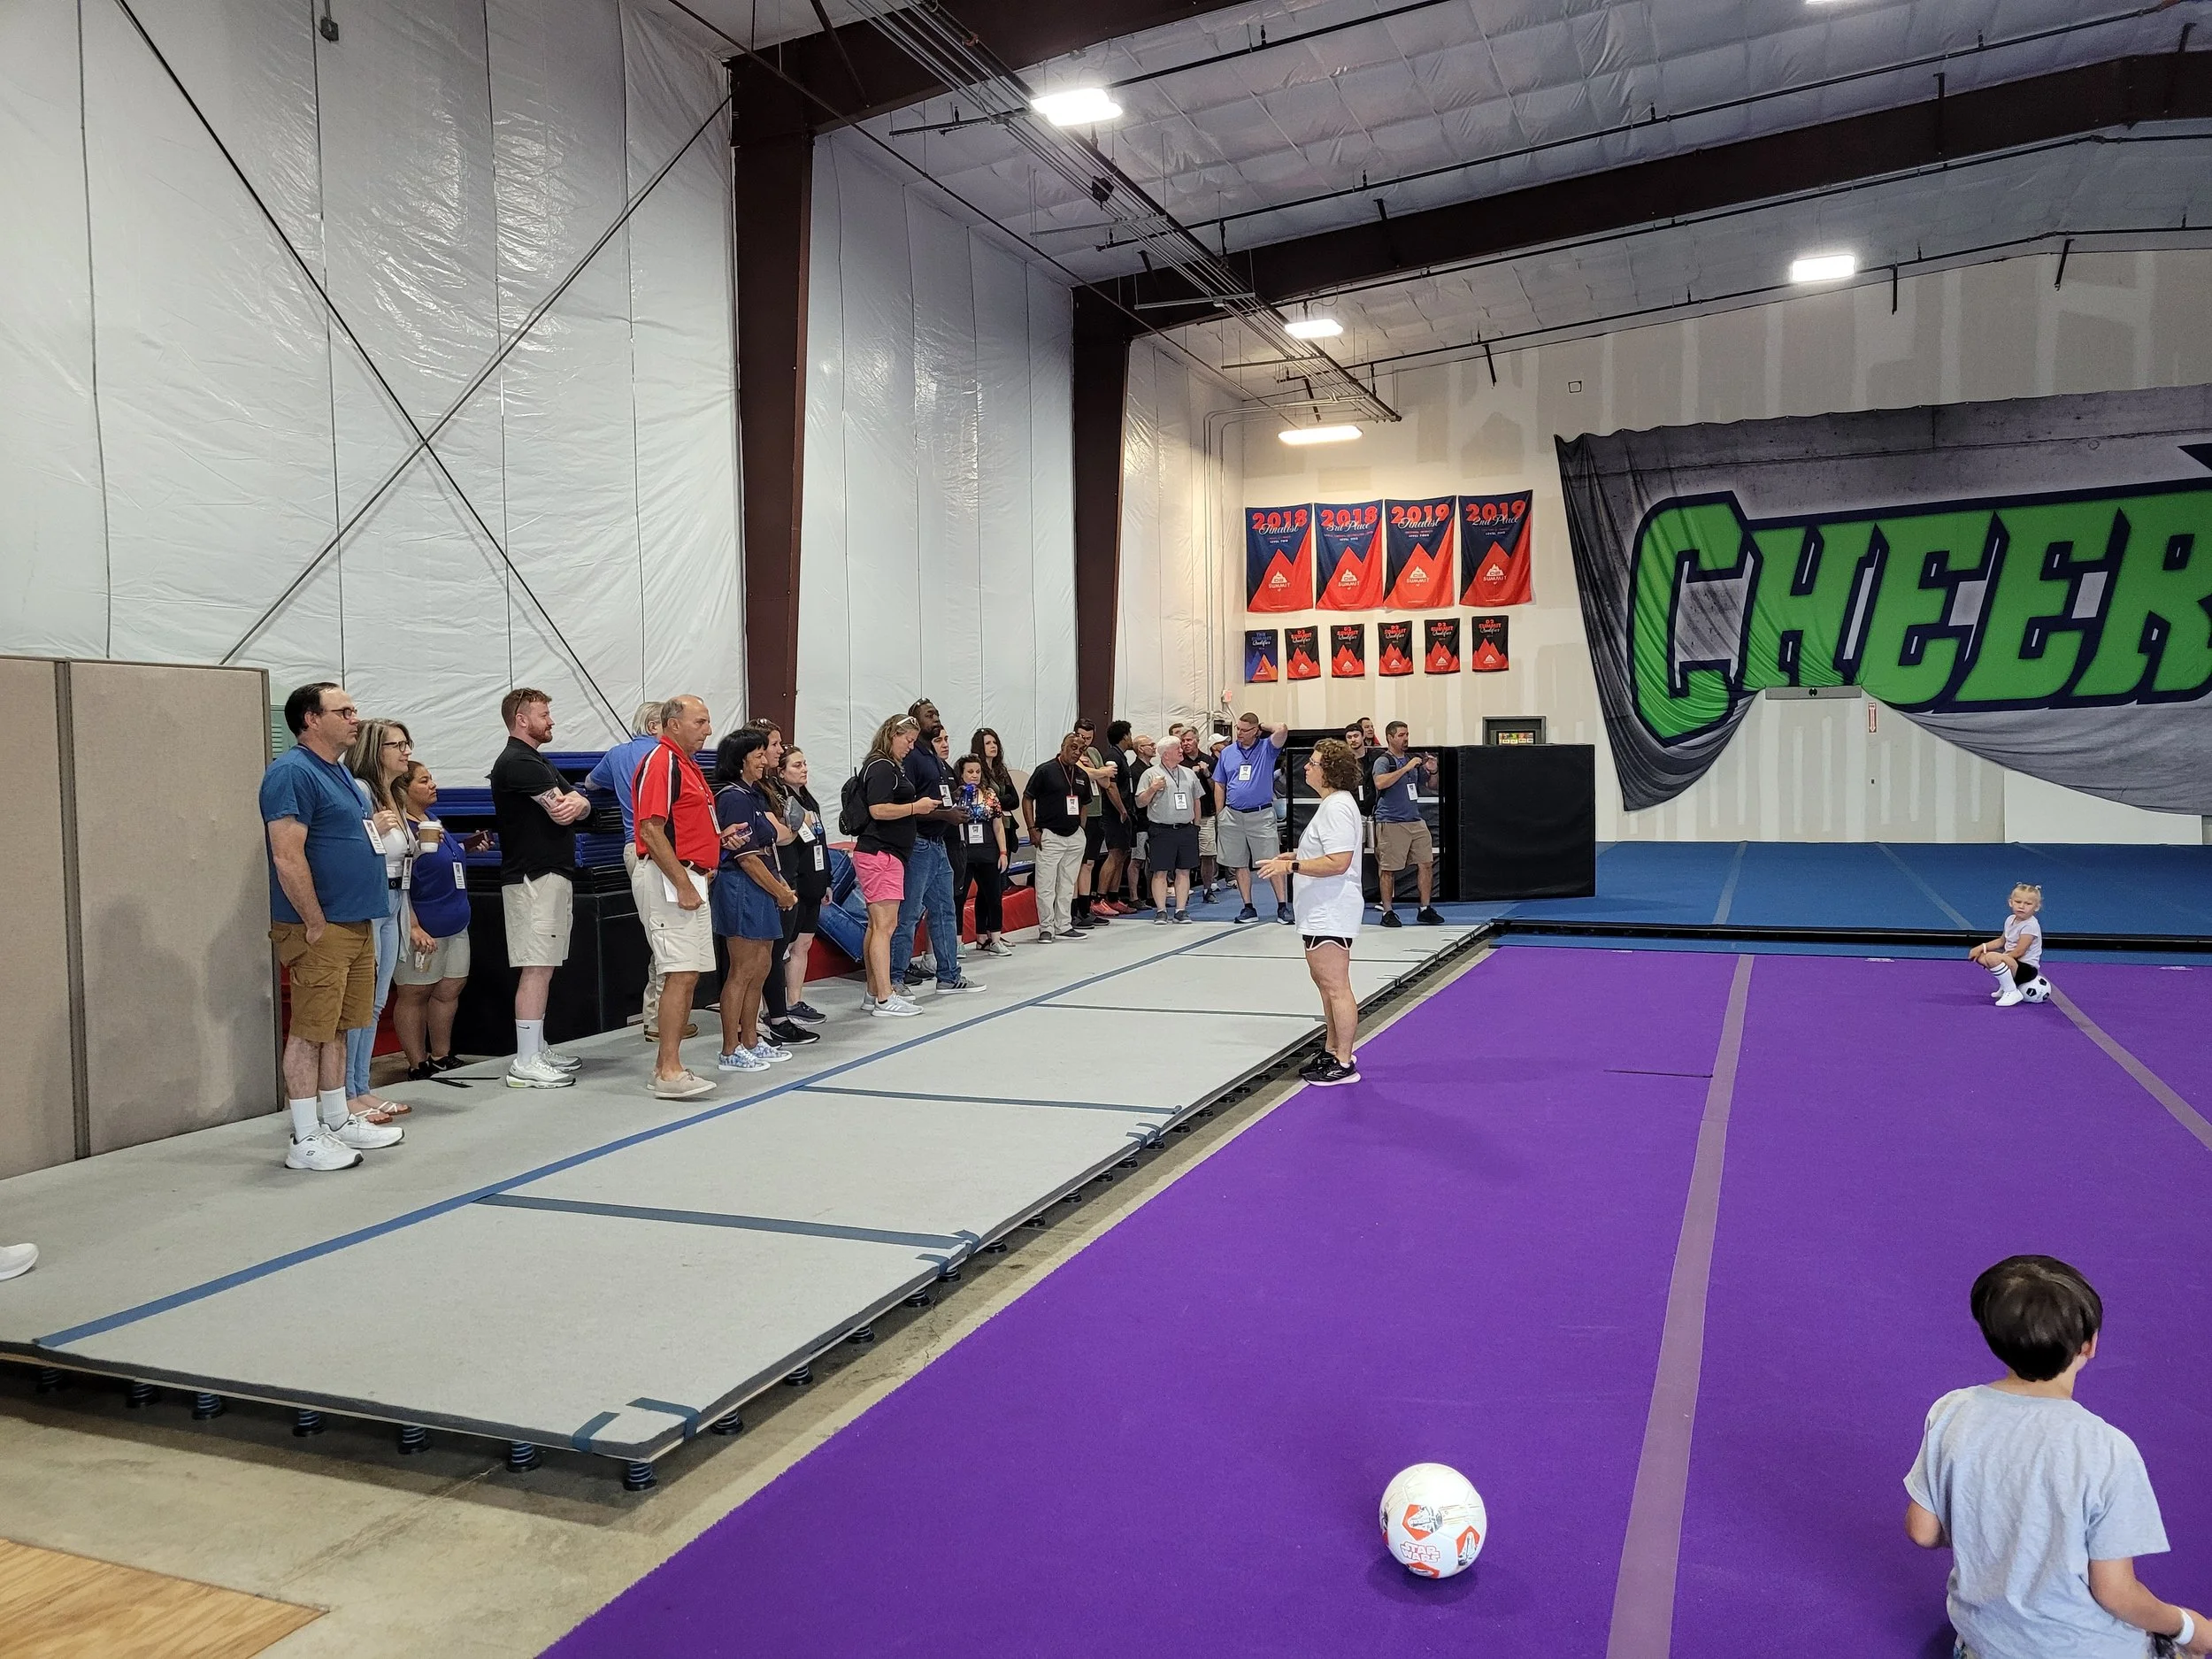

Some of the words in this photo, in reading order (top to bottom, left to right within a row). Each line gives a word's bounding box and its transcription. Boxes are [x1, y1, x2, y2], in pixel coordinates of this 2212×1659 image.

[1321, 505, 1378, 526] 2018
[1390, 503, 1449, 524] 2019
[1465, 500, 1525, 521] 2019
[1252, 509, 1308, 530] 2018
[1326, 521, 1344, 532] 3rd
[1345, 520, 1371, 532] Place
[1398, 516, 1441, 529] Finalist
[1471, 516, 1492, 526] 2nd
[1493, 514, 1519, 526] Place
[1259, 522, 1299, 535] Finalist
[1628, 482, 2212, 745] CHEER
[1400, 1540, 1440, 1555] STAR
[1402, 1548, 1440, 1563] WARS
